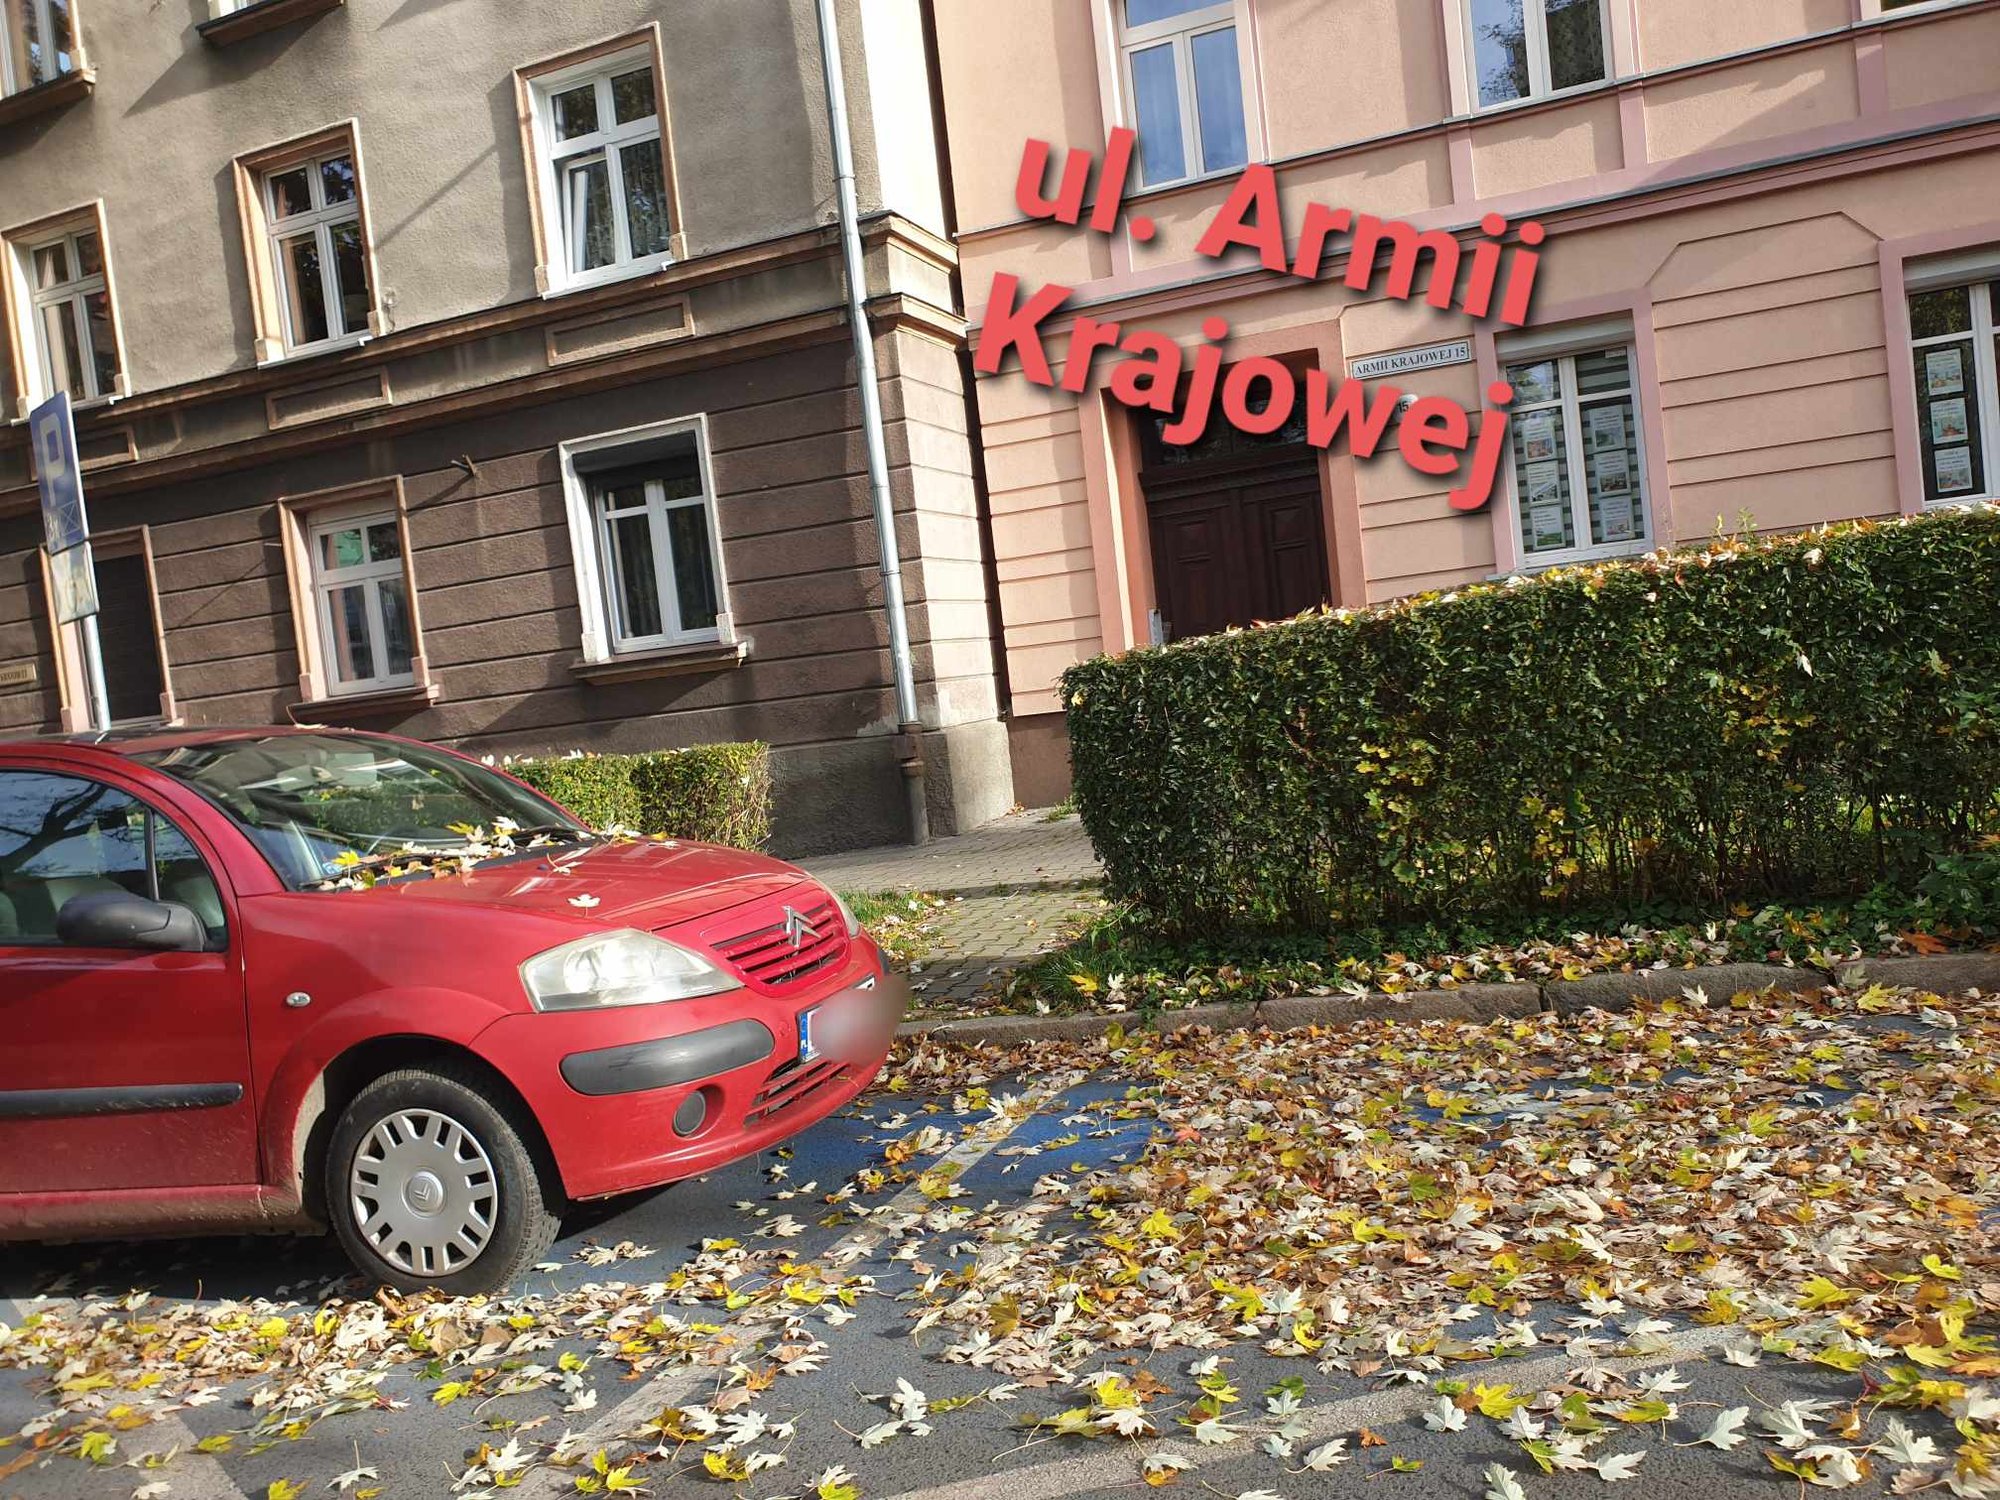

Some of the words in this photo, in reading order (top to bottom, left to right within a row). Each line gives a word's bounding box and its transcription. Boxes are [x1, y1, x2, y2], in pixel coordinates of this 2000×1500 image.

[1355, 361, 1388, 375] ARMII
[1391, 349, 1453, 368] KRAJOWEJ
[1455, 347, 1466, 358] 15
[39, 411, 66, 508] P
